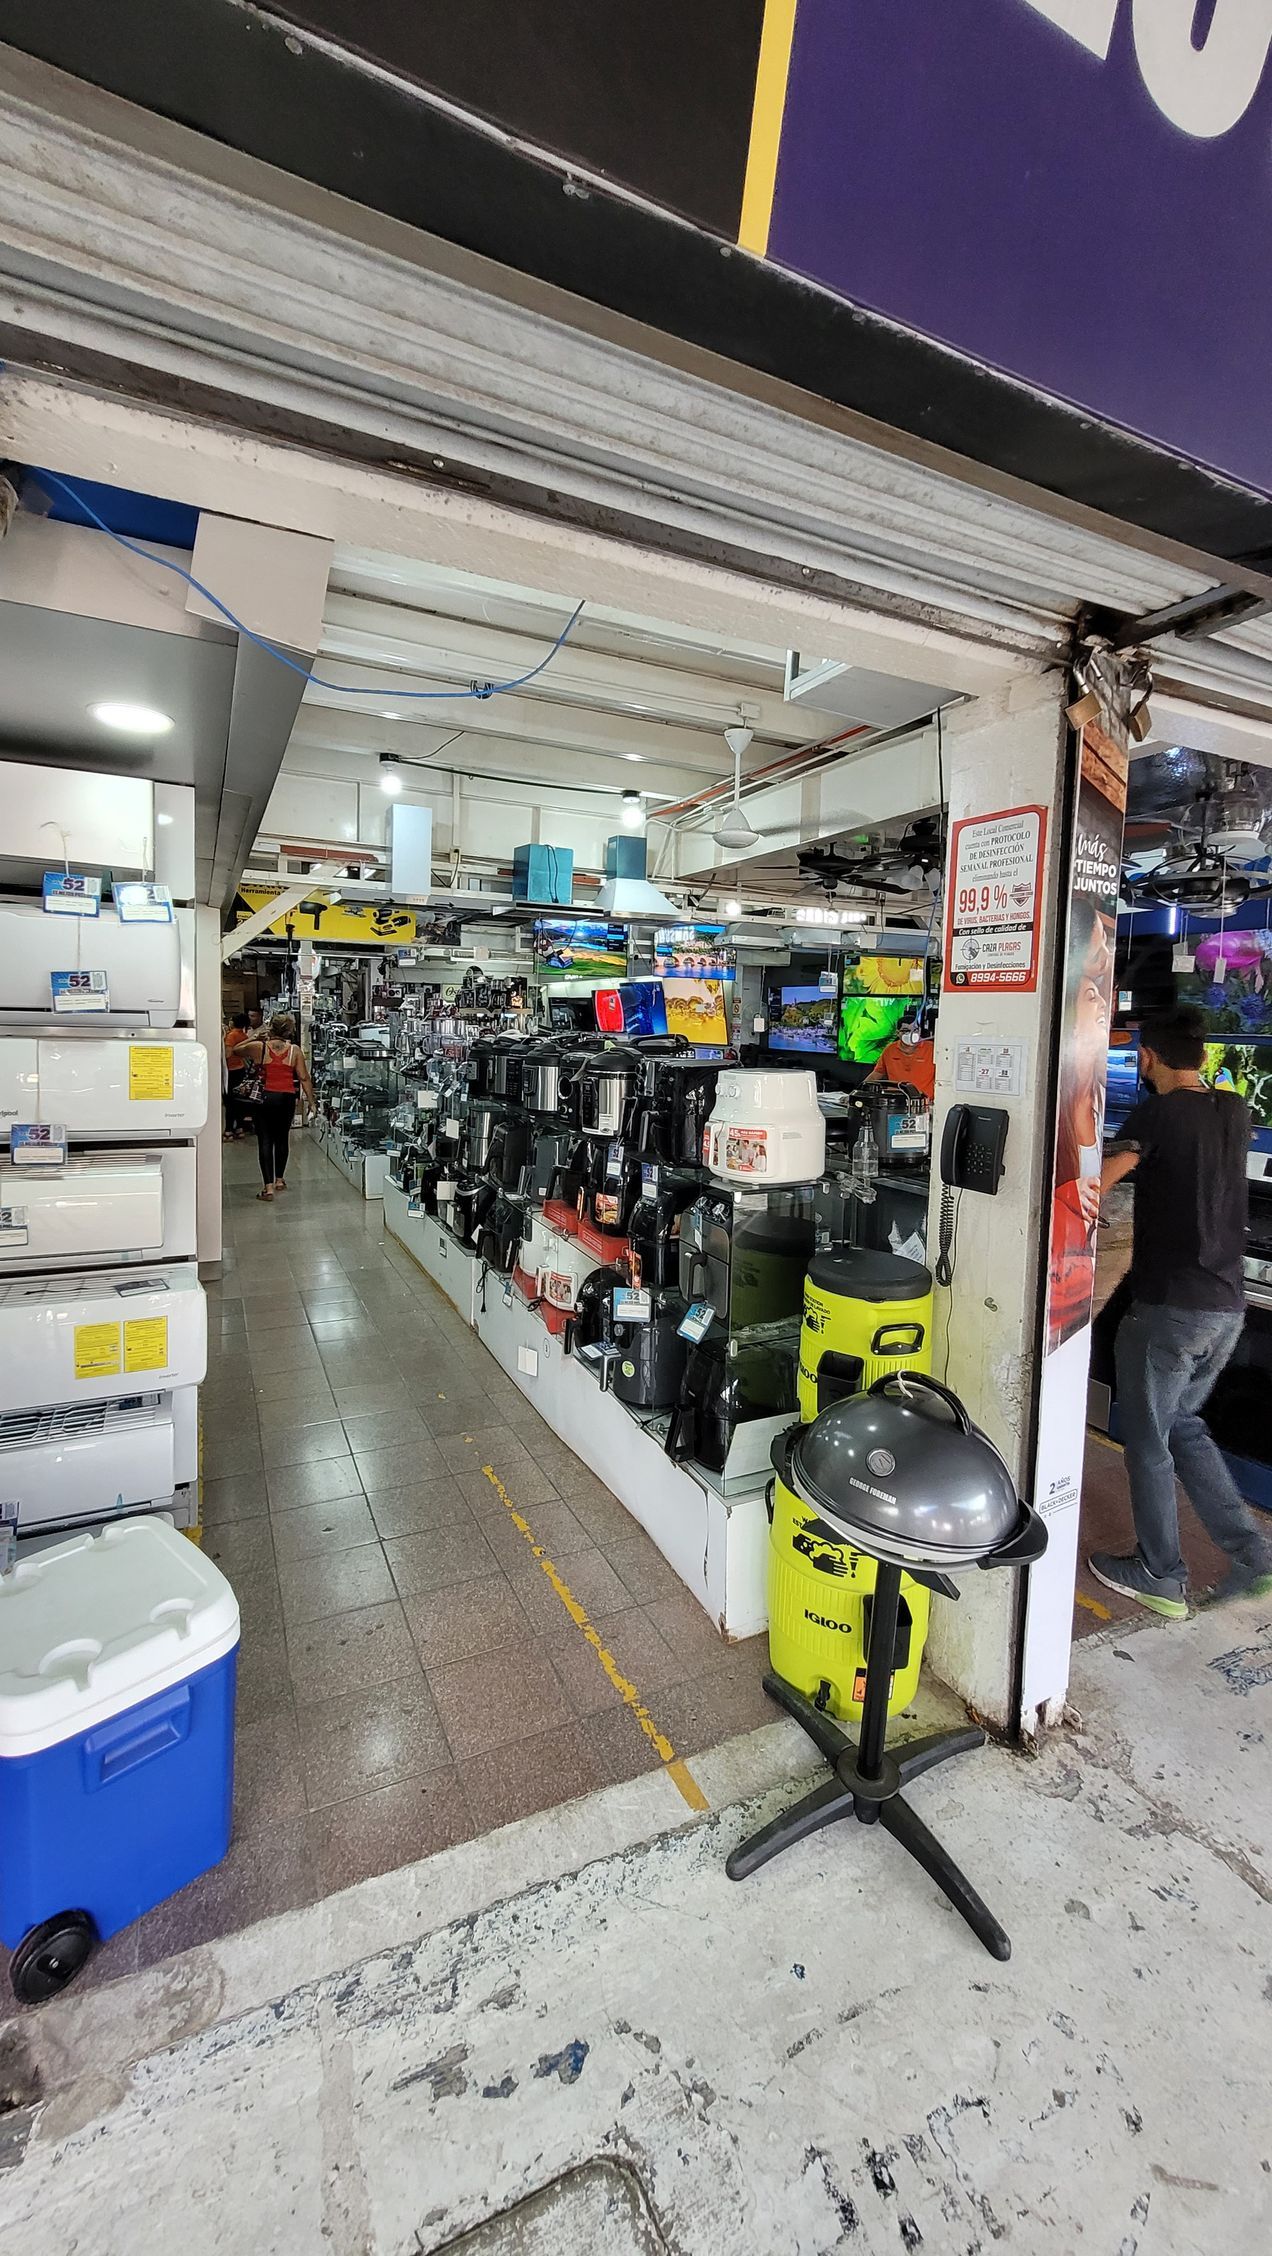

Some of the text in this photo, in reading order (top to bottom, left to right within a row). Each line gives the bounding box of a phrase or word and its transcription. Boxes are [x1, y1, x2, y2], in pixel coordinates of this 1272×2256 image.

[983, 825, 998, 835] Local
[991, 830, 1031, 846] PROTOCOLO
[969, 842, 1024, 860] DE DESINFECCIÓN
[960, 853, 1034, 873] SEMANAL PROFESIONAL
[1075, 859, 1117, 878] TIEMPO
[63, 878, 85, 892] 52
[240, 887, 281, 896] Herramienta
[1073, 876, 1117, 896] JUNTOS
[978, 913, 1006, 924] BACTERIAS
[958, 928, 970, 936] Con
[970, 927, 985, 935] sello
[994, 924, 1017, 932] calidad
[1017, 923, 1027, 931] de
[982, 941, 1022, 953] CAZA PLAGAS
[986, 961, 1026, 969] Desinfecciones
[68, 975, 91, 987] 52
[970, 971, 1027, 983] 8994-5666
[901, 1119, 916, 1129] 52
[28, 1127, 51, 1140] 52
[626, 1290, 640, 1301] 52
[695, 1306, 707, 1320] 52
[849, 1477, 897, 1505] GEORGE FOREMAN
[1049, 1482, 1056, 1495] 2
[804, 1608, 853, 1634] IGLOO
